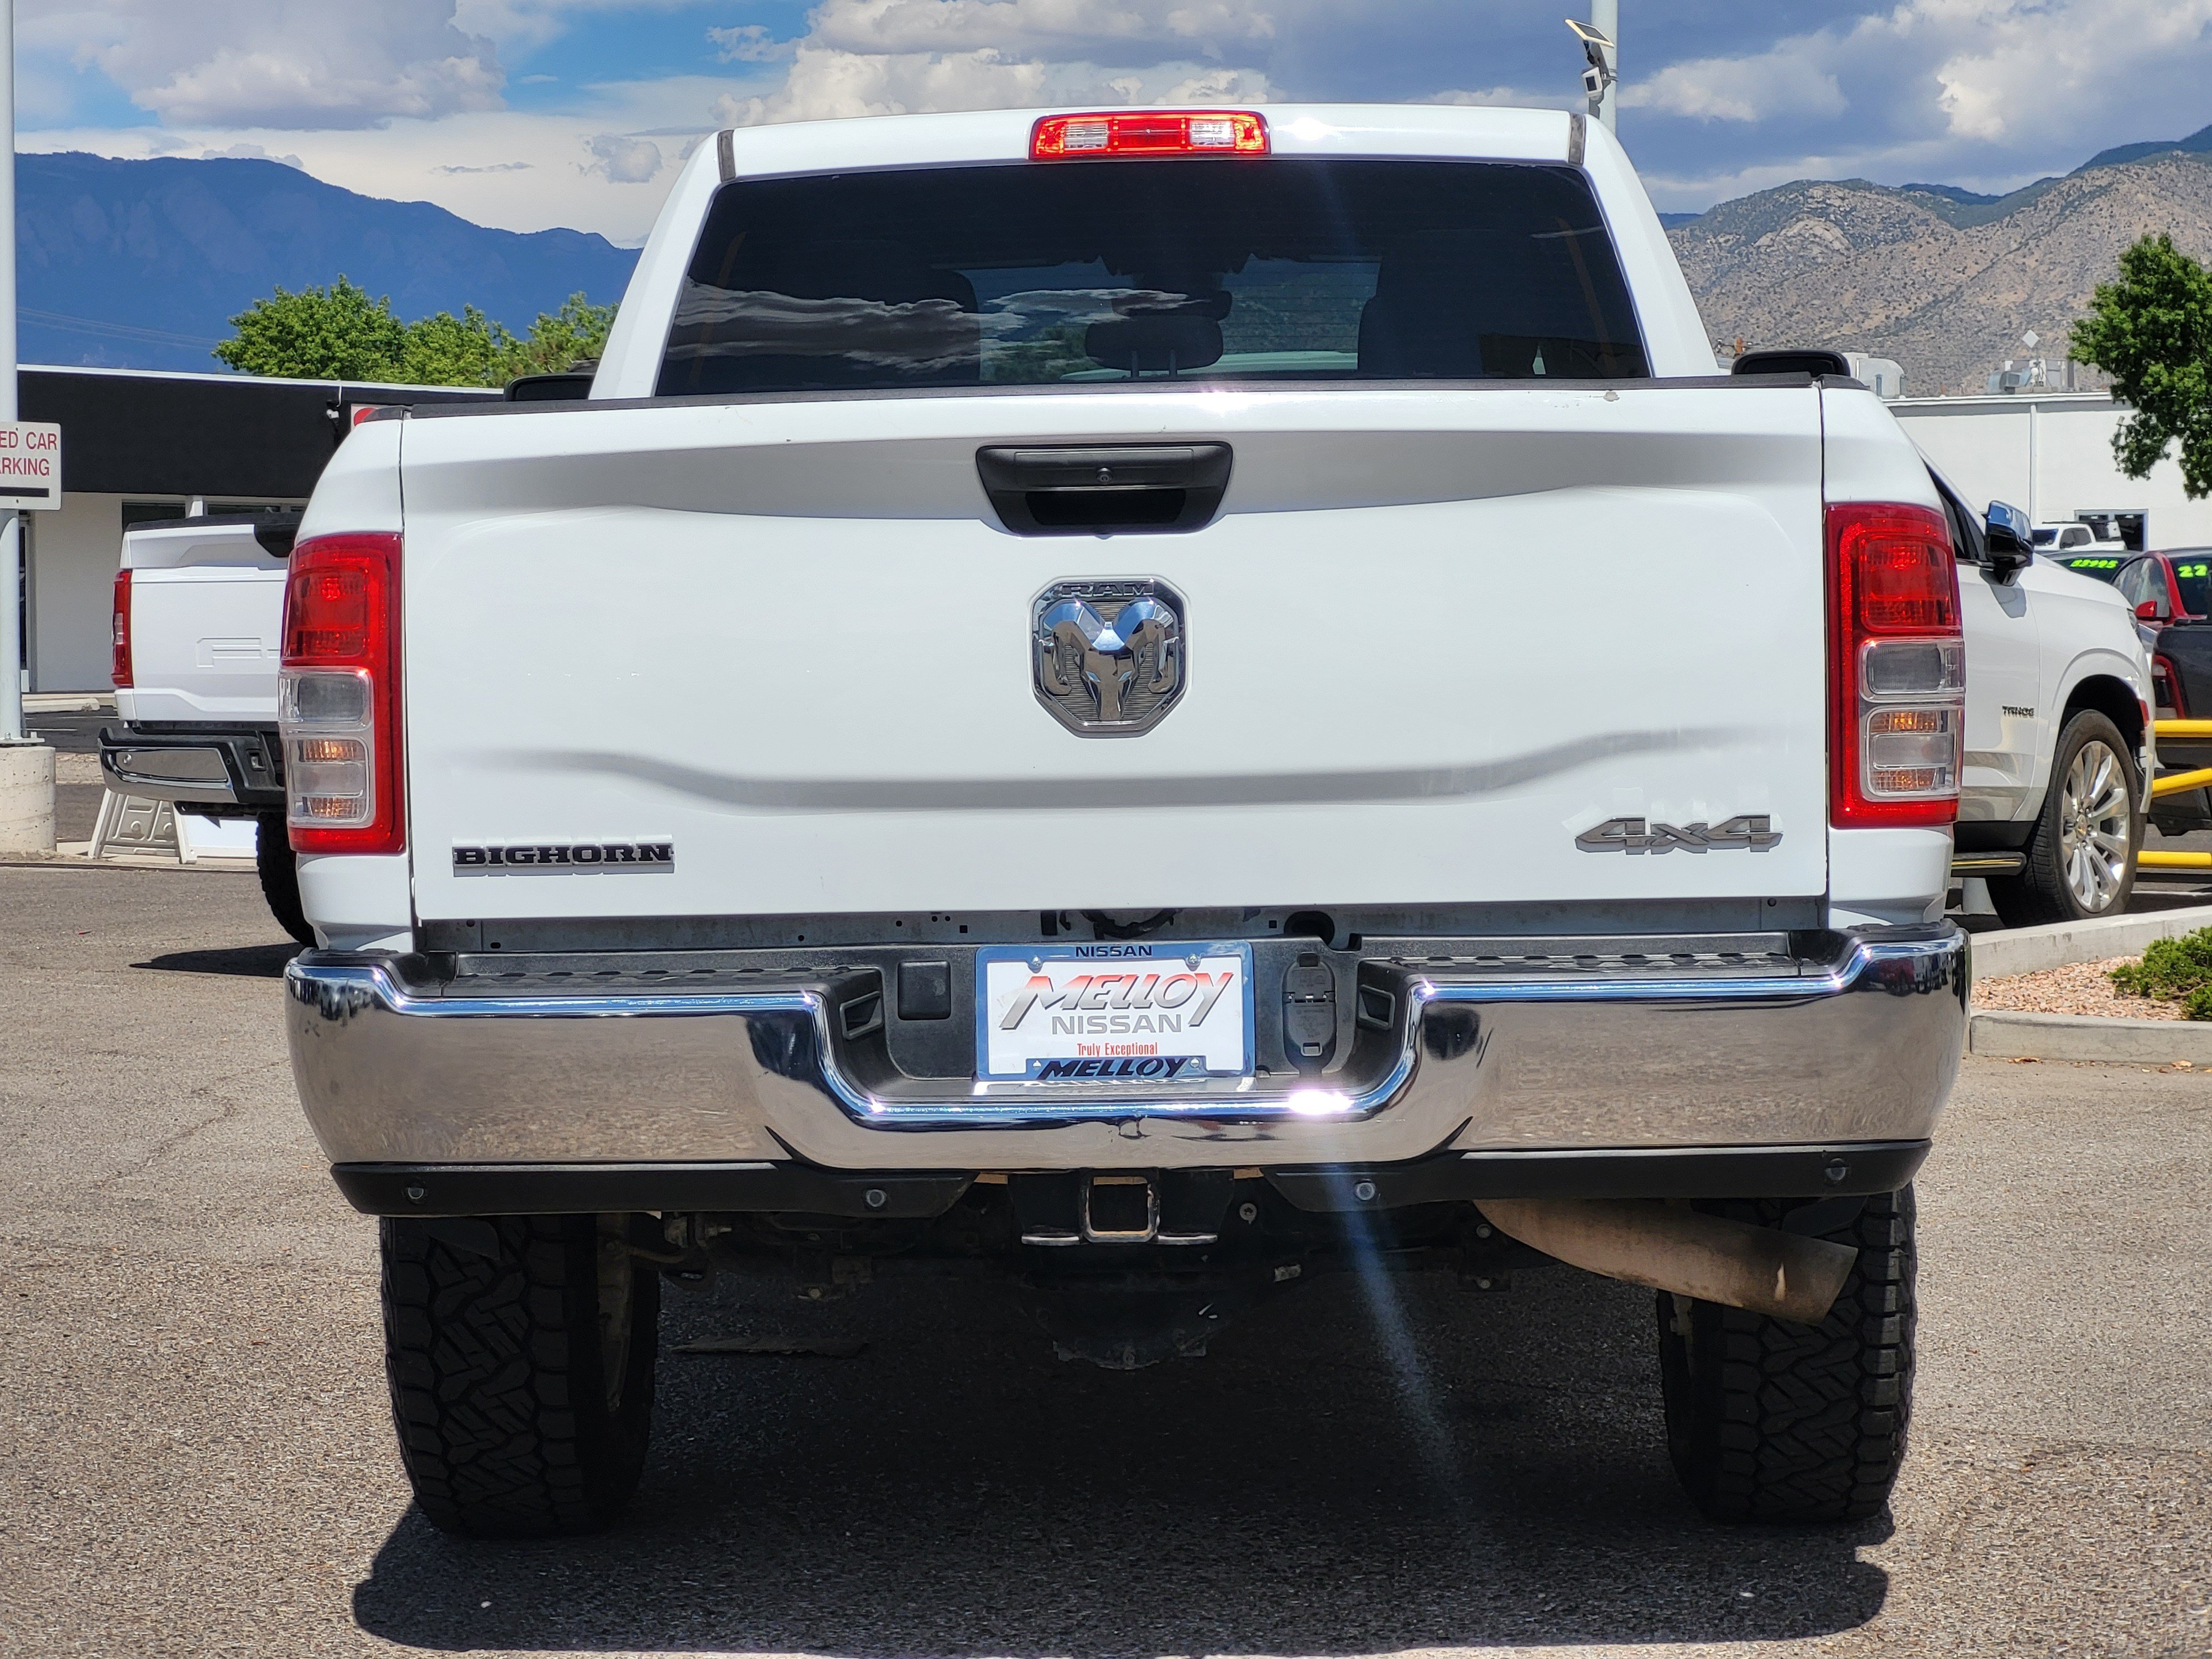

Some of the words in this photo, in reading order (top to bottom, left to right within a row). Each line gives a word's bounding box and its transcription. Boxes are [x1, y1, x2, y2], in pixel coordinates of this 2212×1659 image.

[25, 431, 58, 450] CAR
[0, 457, 50, 476] RKING
[2178, 564, 2208, 578] 22
[1061, 583, 1154, 597] RAM
[2002, 705, 2034, 718] TAHOE
[452, 843, 674, 868] BIGHORN
[1075, 946, 1152, 958] NISSAN
[999, 972, 1234, 1030] MELLOY
[1051, 1014, 1182, 1035] NISSAN
[1077, 1044, 1101, 1057] Truly
[1104, 1042, 1159, 1057] Exceptional
[1037, 1058, 1188, 1080] MELLOY
